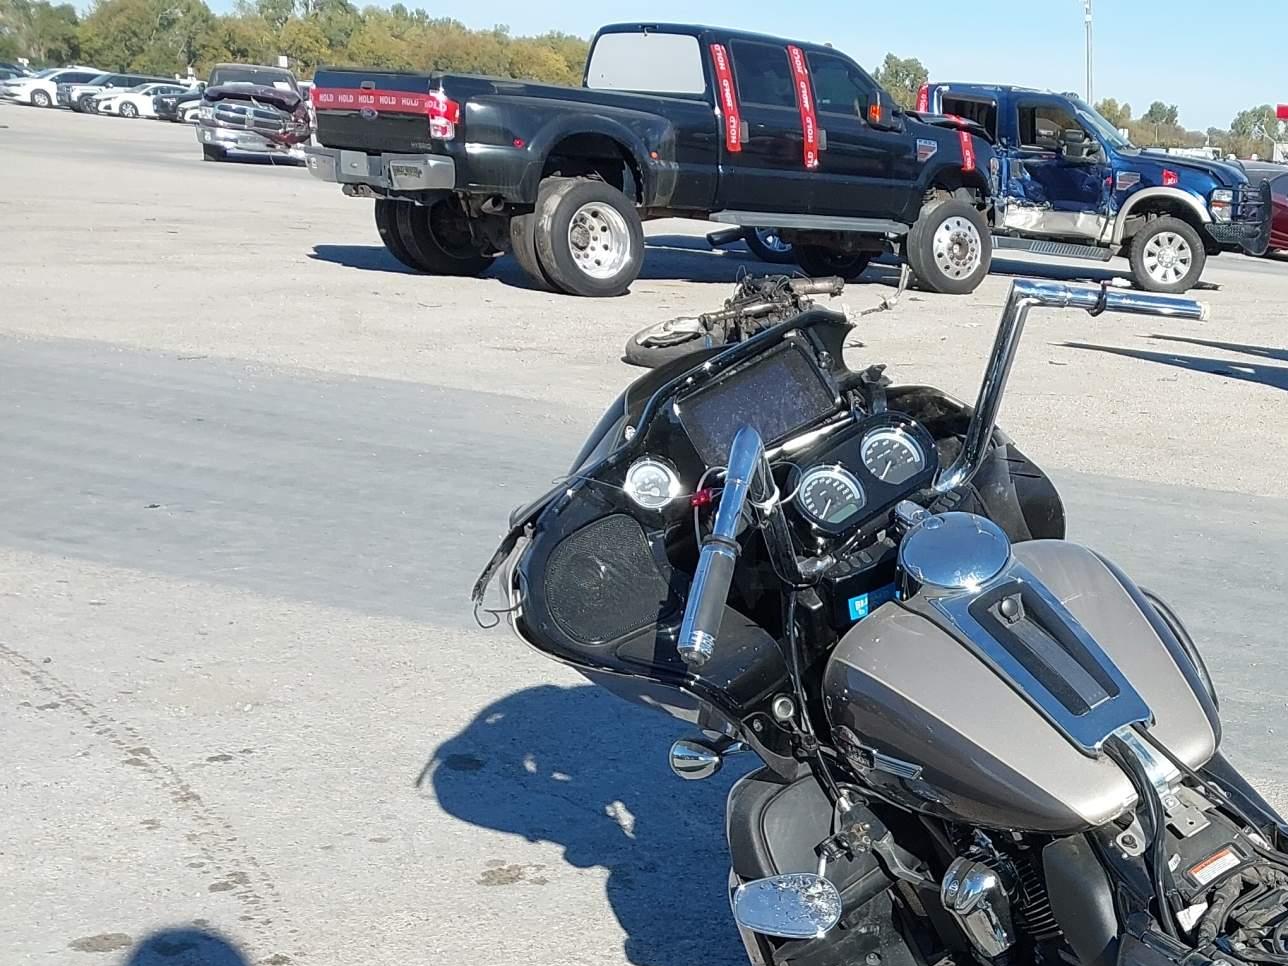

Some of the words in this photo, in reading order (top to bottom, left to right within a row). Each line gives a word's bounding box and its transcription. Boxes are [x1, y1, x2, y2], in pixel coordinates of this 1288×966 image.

[714, 43, 726, 70] HOLD
[338, 94, 354, 103] HOLD
[358, 94, 375, 104] HOLD
[379, 95, 397, 105] HOLD
[401, 97, 419, 107] HOLD
[729, 115, 737, 144] HOLD
[805, 116, 814, 143] HOLD
